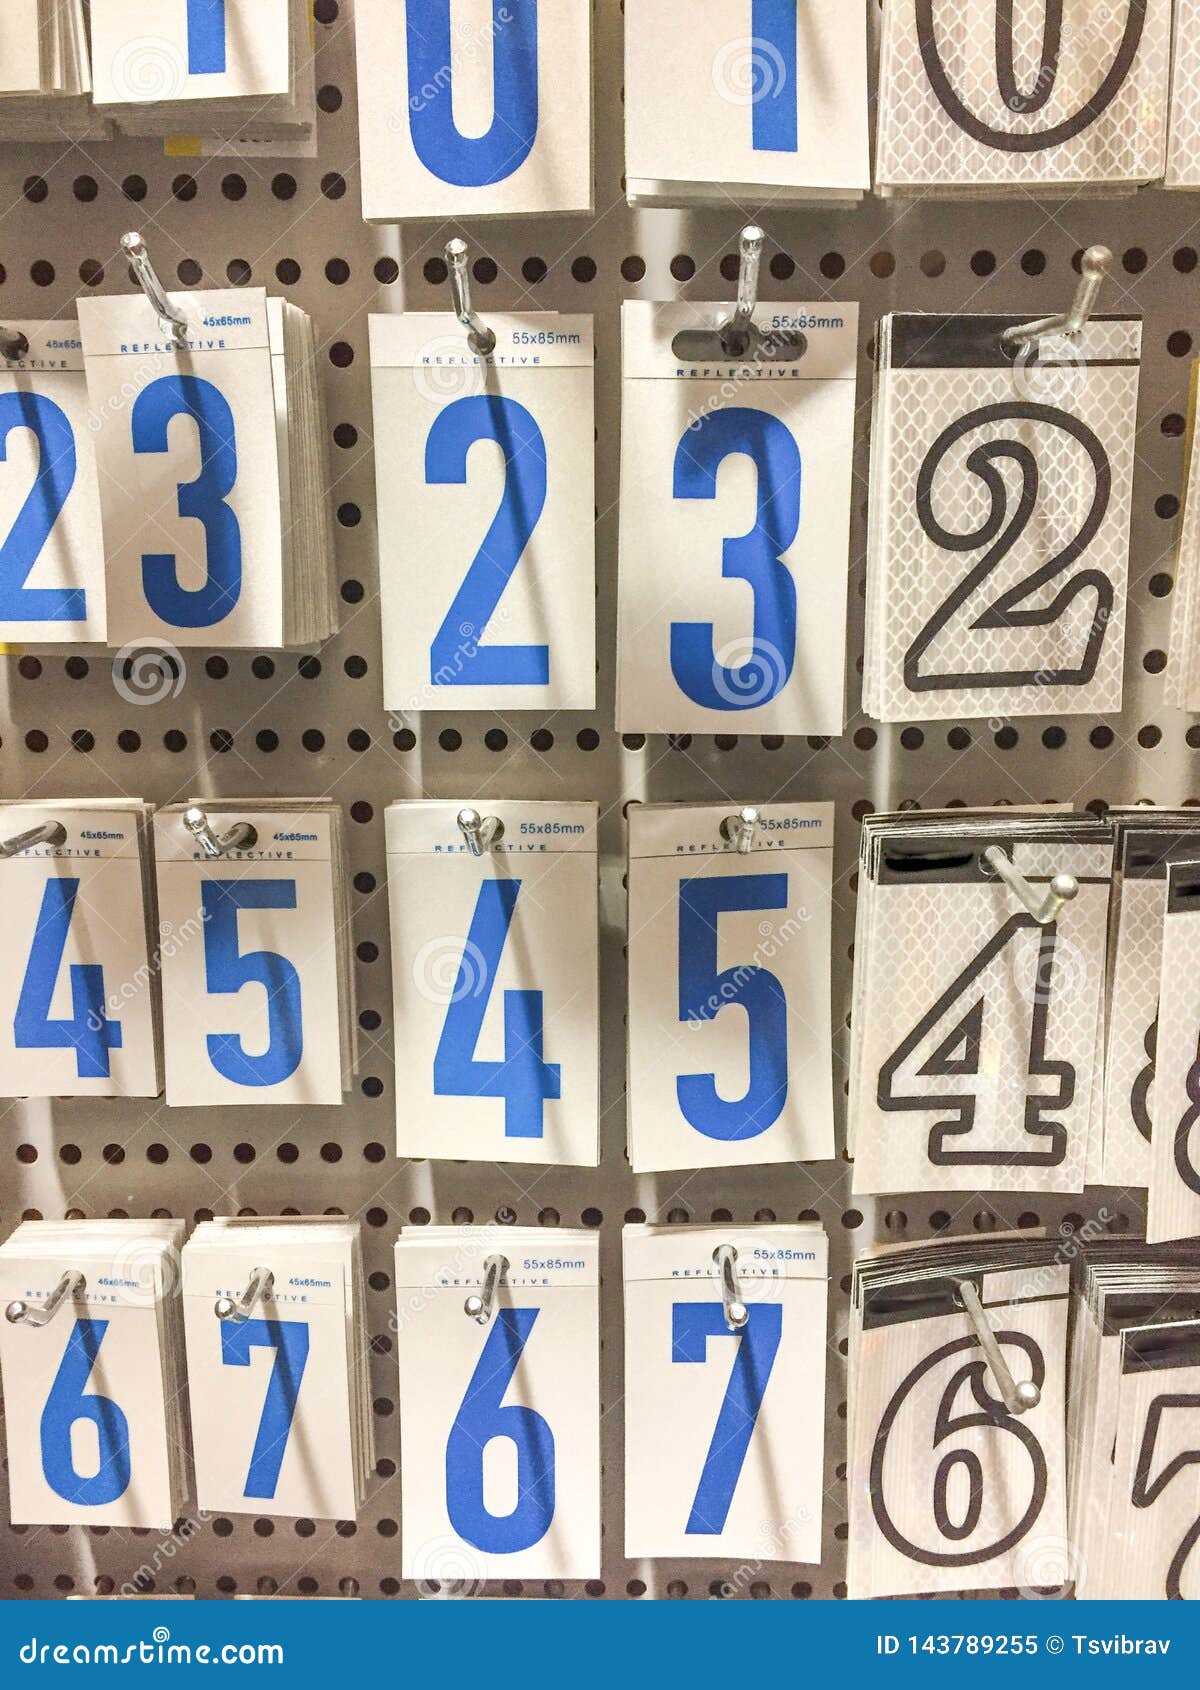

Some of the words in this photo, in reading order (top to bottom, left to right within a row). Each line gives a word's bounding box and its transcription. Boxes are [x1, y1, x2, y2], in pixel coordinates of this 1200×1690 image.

[202, 315, 251, 327] 45x65mm
[422, 356, 541, 365] REFLECTIVE
[511, 331, 581, 345] 55x85mm
[771, 315, 844, 329] 55x85mm
[676, 368, 801, 377] REFLECTIVE
[0, 392, 87, 622] 2
[131, 375, 242, 628] 3
[425, 395, 550, 685] 2
[904, 401, 1113, 693] 2
[670, 407, 802, 711] 3
[80, 831, 125, 840] 45x65mm
[434, 844, 547, 852] REFCTIVE
[520, 822, 585, 834] 55x85mm
[676, 840, 785, 852] REFLEIVE
[759, 817, 823, 831] 55x85mm
[14, 877, 122, 1078] 4
[202, 880, 303, 1087] 5
[433, 879, 561, 1138] 4
[676, 873, 788, 1141] 5
[877, 911, 1075, 1166] 4
[216, 1290, 308, 1302] REFCTIVE
[441, 1278, 549, 1286] REFLCTIVE
[523, 1259, 586, 1270] 55x85mm
[672, 1268, 780, 1277] REFLTIVE
[753, 1249, 816, 1261] 55x85mm
[40, 1319, 131, 1506] 6
[220, 1318, 310, 1499] 7
[446, 1308, 555, 1554] 6
[672, 1302, 783, 1535] 7
[870, 1331, 1048, 1568] 6
